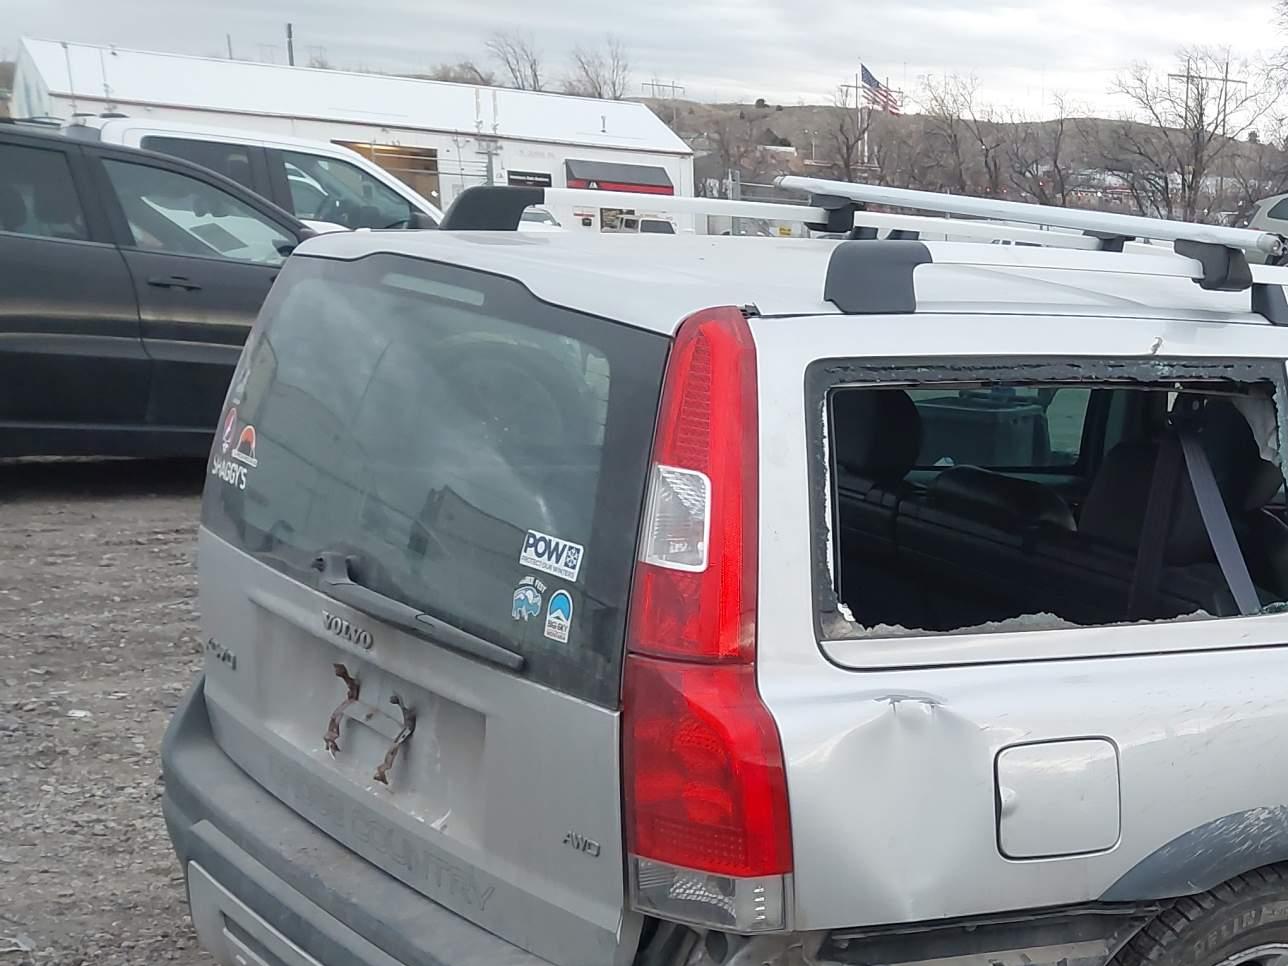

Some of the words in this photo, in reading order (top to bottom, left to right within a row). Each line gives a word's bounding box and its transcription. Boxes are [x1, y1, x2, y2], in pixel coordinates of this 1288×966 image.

[524, 532, 567, 564] POW
[322, 609, 374, 650] VOLVO
[562, 830, 601, 857] AWD
